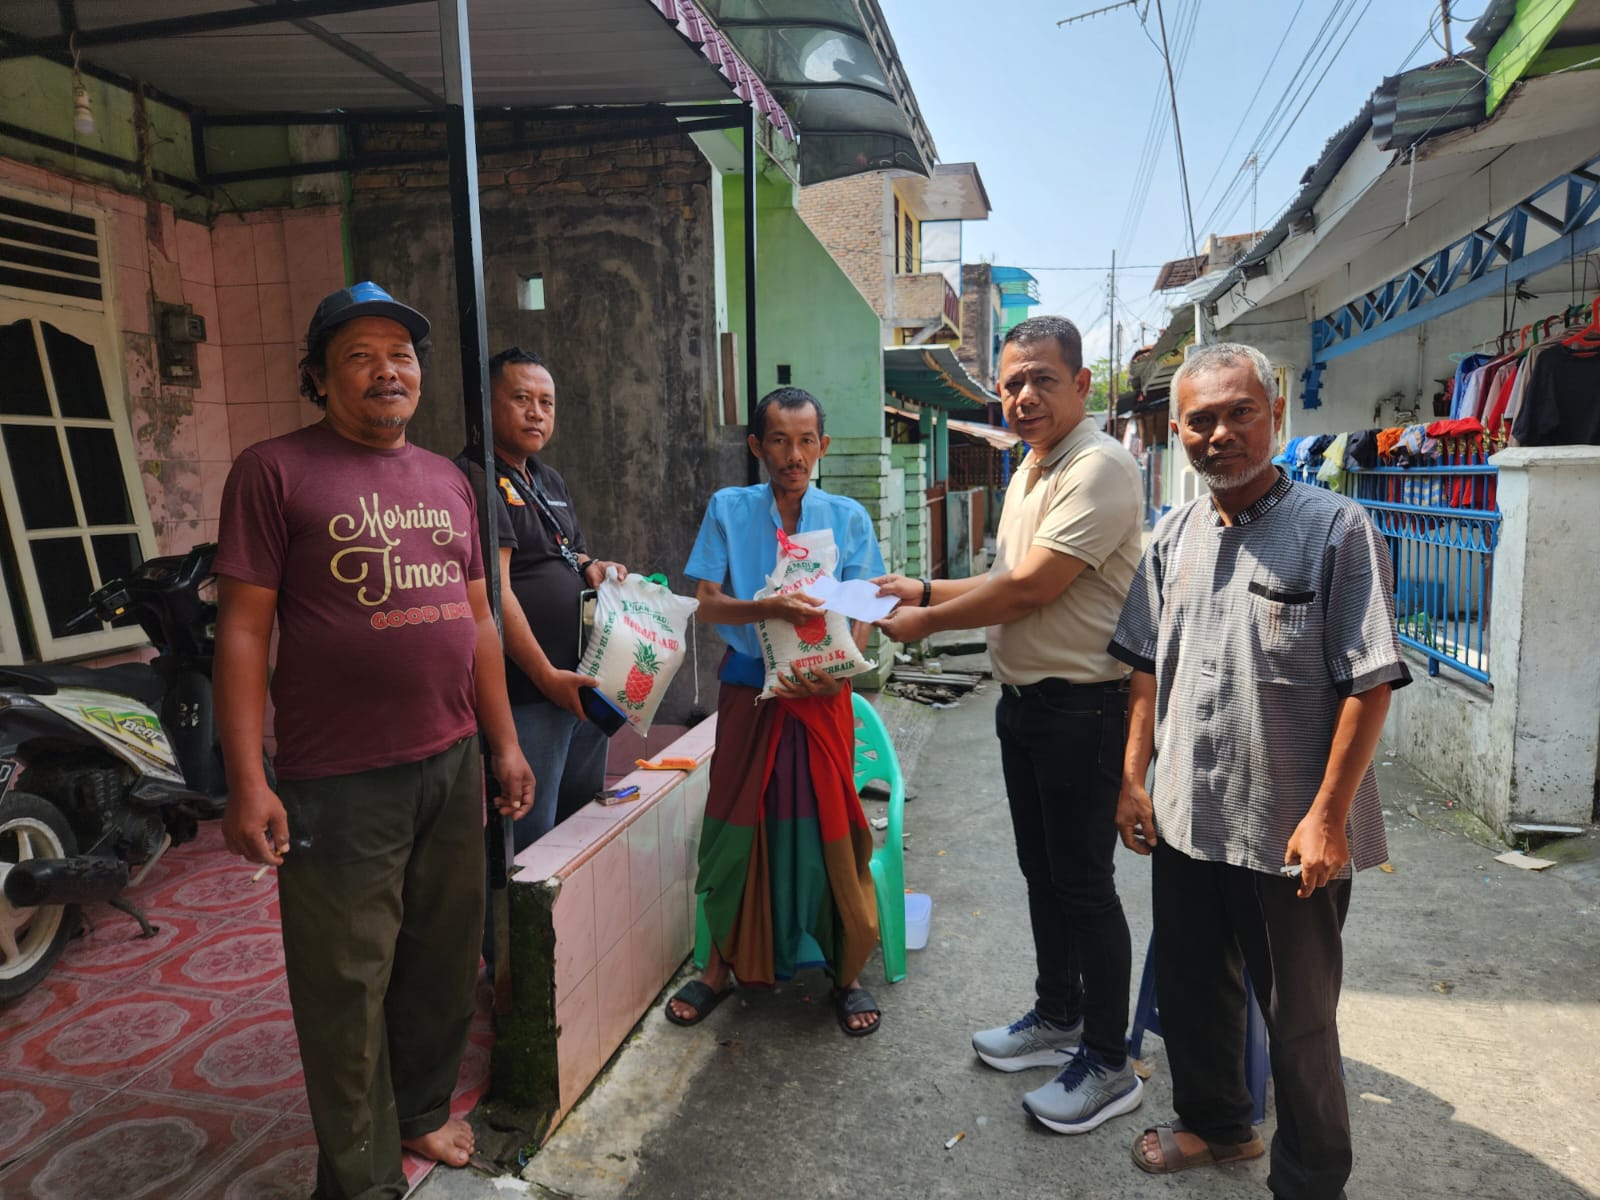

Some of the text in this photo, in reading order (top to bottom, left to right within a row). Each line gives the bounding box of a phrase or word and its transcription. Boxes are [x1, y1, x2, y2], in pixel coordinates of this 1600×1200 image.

[329, 492, 467, 546] Morning
[330, 545, 461, 606] Time
[371, 606, 440, 630] GOOD
[822, 660, 855, 674] ERBAIK
[828, 652, 834, 661] 5
[835, 649, 846, 660] Kg
